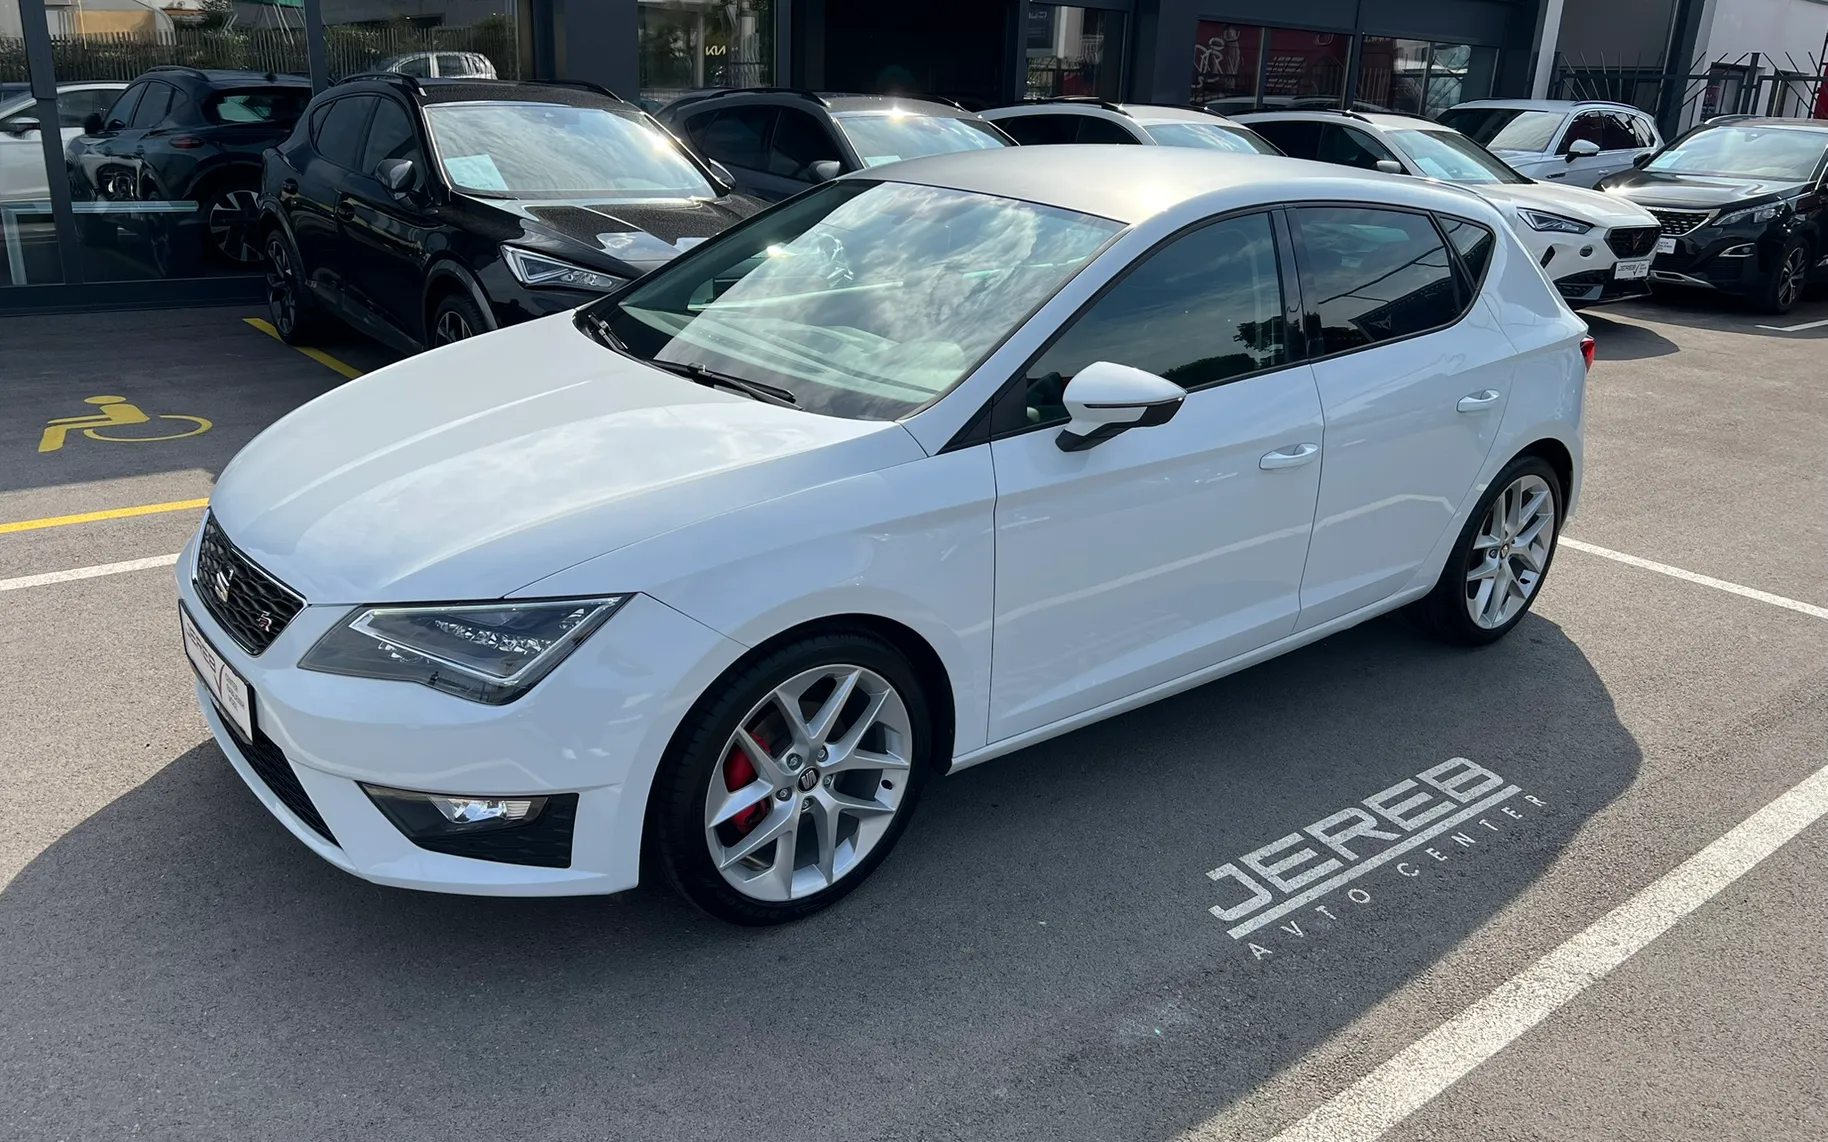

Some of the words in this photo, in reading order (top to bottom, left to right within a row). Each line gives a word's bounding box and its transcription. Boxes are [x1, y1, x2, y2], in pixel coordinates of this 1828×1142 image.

[1205, 756, 1504, 921] JEREB
[1248, 888, 1371, 960] AVTO
[1396, 793, 1547, 877] CENTER
